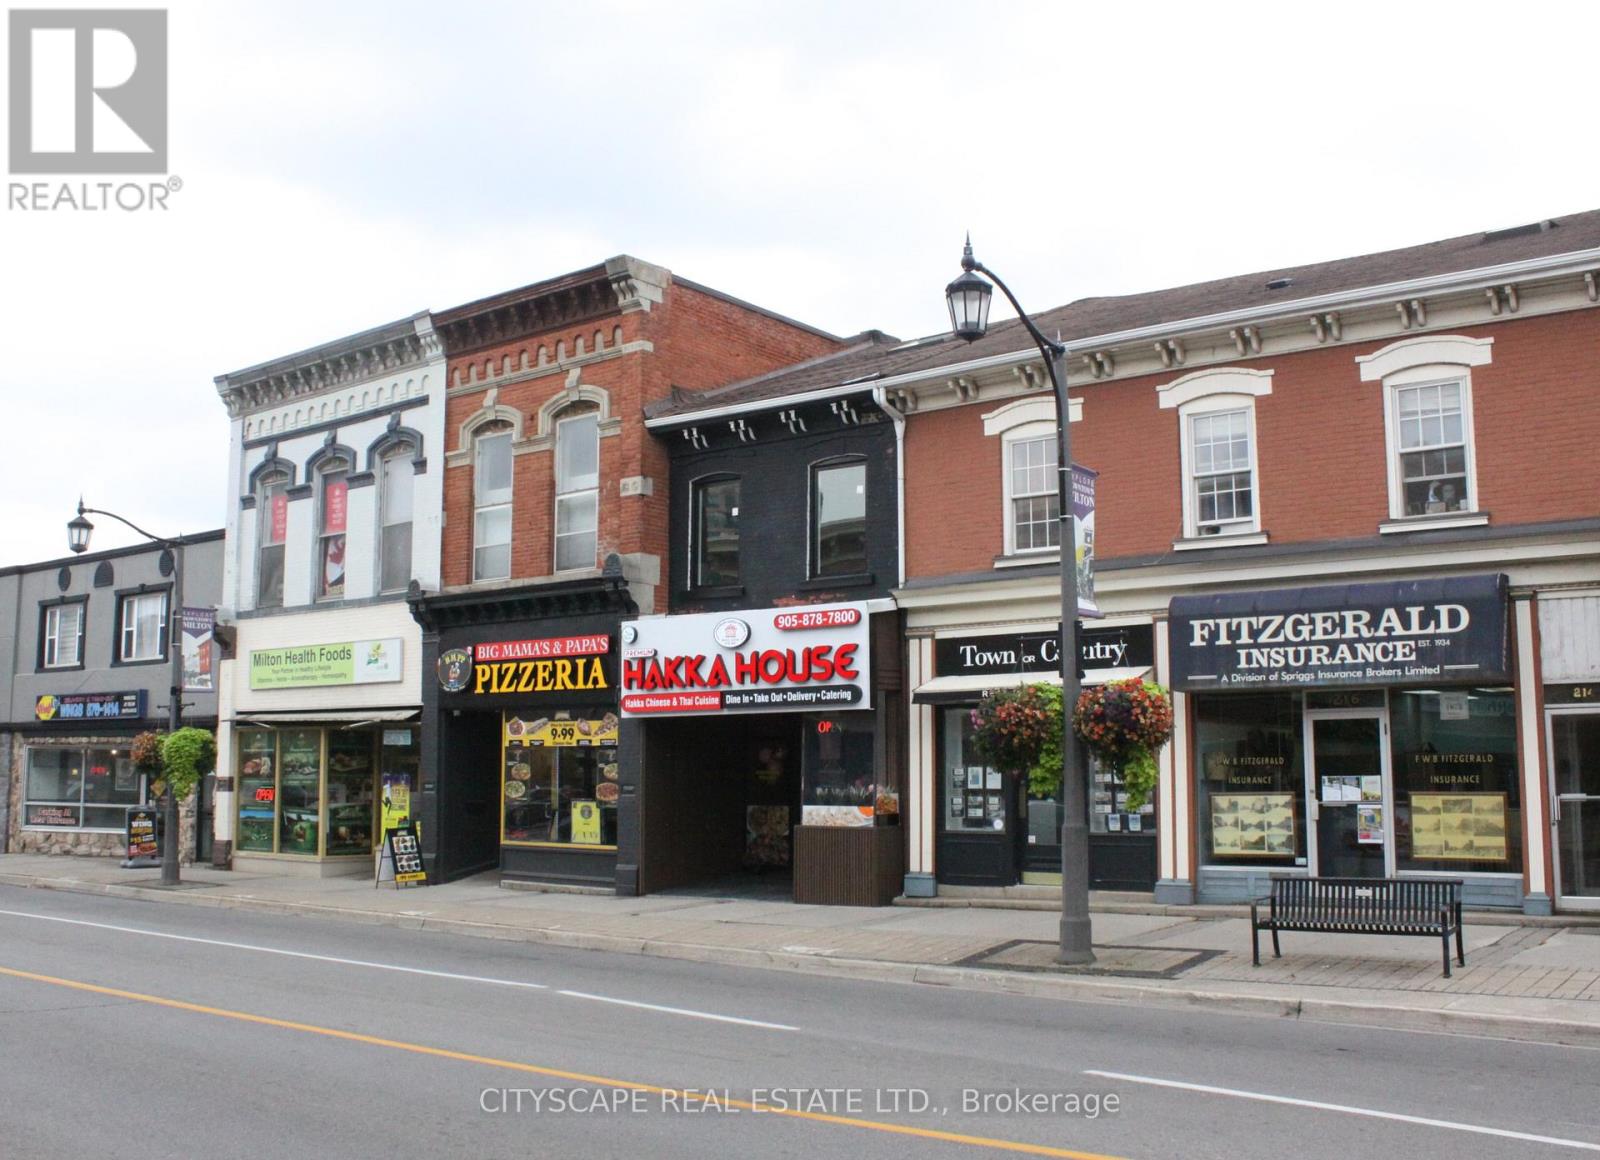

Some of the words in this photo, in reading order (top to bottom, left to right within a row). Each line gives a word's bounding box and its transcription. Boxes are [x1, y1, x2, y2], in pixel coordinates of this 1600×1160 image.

[778, 611, 855, 628] 905-878-7800
[1189, 604, 1471, 646] FITZGERALD
[478, 645, 499, 659] BIG
[502, 641, 550, 657] MAMA'S
[553, 641, 562, 654] &
[565, 637, 608, 653] PAPA'S
[1418, 640, 1432, 648] EST.
[1435, 639, 1451, 647] 1934
[253, 653, 281, 667] Milton
[285, 649, 316, 664] Health
[319, 646, 352, 661] Foods
[625, 650, 654, 658] PREMIUM
[960, 645, 1017, 667] Town
[1237, 641, 1417, 669] INSURANCE
[474, 657, 607, 694] PIZZERIA
[623, 654, 731, 690] HAKKA
[735, 644, 859, 684] HOUSE
[1221, 674, 1229, 682] A
[1231, 673, 1266, 682] Division
[1269, 672, 1279, 680] of
[1281, 671, 1315, 681] Spriggs
[1318, 669, 1363, 678] Insurance
[1366, 667, 1402, 676] Brokers
[1405, 665, 1440, 674] Limited
[625, 698, 645, 708] Hakka
[646, 697, 671, 707] Chinese
[672, 697, 678, 706] &
[680, 696, 694, 705] Thai
[695, 695, 719, 705] Cuisine
[726, 694, 741, 704] Dine
[743, 694, 749, 703] In
[753, 693, 769, 703] Take
[771, 692, 782, 702] Out
[787, 691, 816, 703] Delivery
[821, 690, 851, 702] Catering
[551, 728, 575, 740] 9.99
[1442, 754, 1494, 763] FITZGERALD
[1229, 775, 1272, 784] INSURANCE
[1430, 775, 1479, 784] INSURANCE
